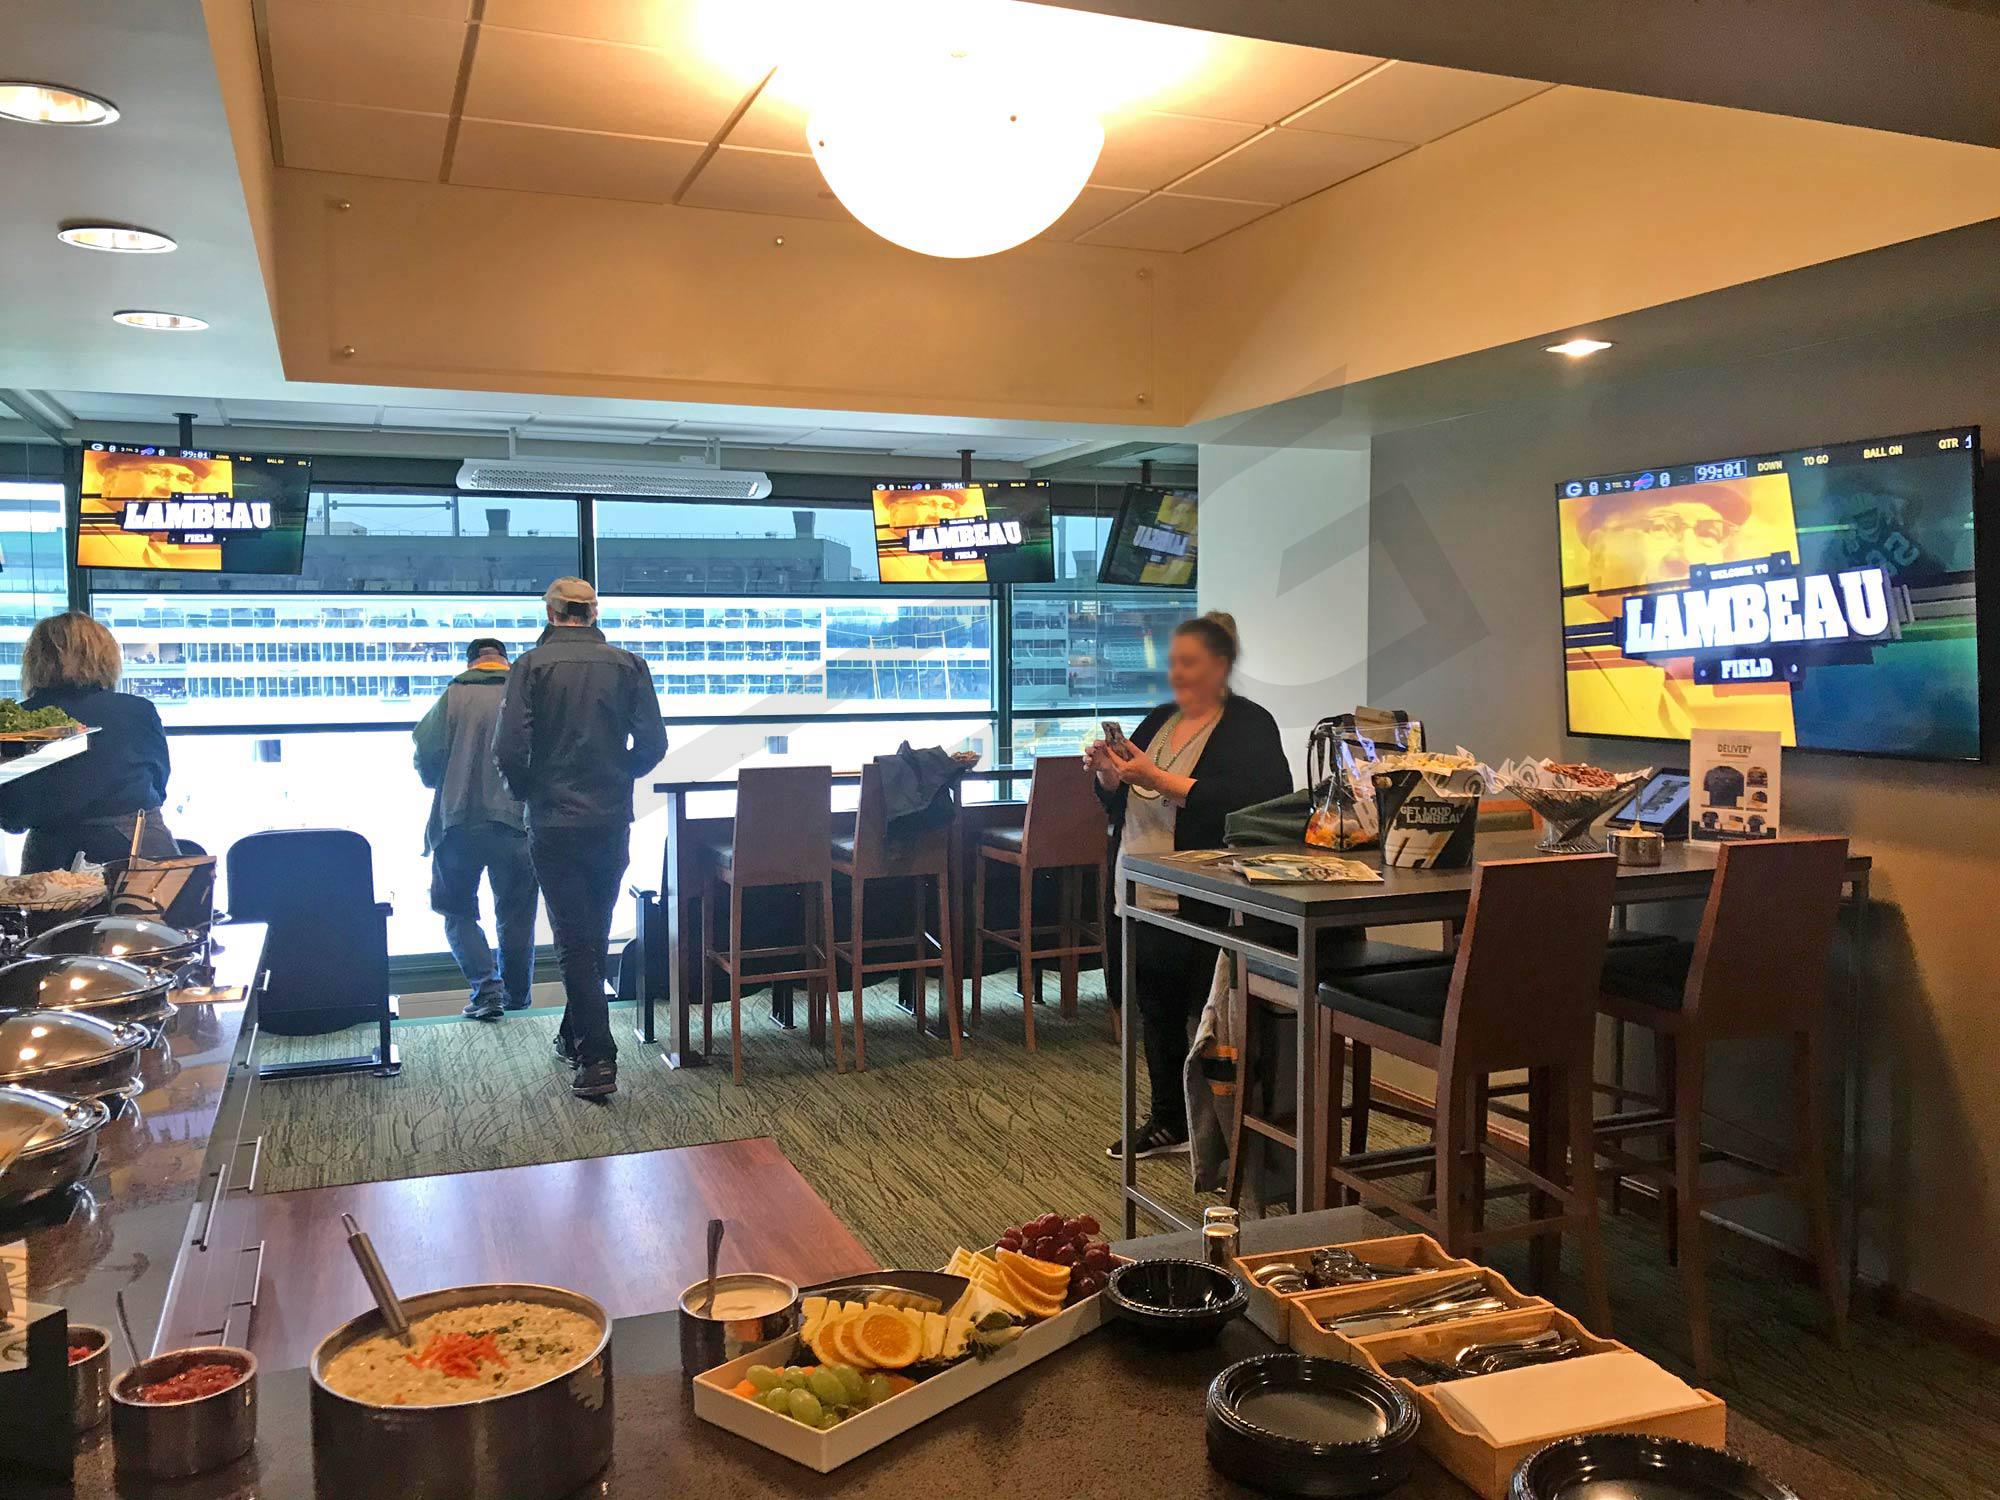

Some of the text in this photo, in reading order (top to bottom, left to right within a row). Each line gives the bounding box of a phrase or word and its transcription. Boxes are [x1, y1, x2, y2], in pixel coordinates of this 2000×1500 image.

[1757, 460, 1782, 472] DOWN
[1803, 456, 1814, 466] TO
[1815, 454, 1829, 465] GO
[1863, 446, 1887, 459] BALL
[1889, 445, 1903, 456] ON
[1938, 437, 1959, 450] QTR
[1698, 463, 1744, 480] 99:01
[123, 502, 271, 529] LAMBEAU
[184, 533, 214, 543] FIELD
[908, 521, 1022, 551] LAMBEAU
[1625, 569, 1889, 654] LAMBEAU
[1721, 658, 1773, 679] FIELD
[1717, 743, 1752, 754] DELIVERY
[1400, 806, 1451, 817] GET LOUD
